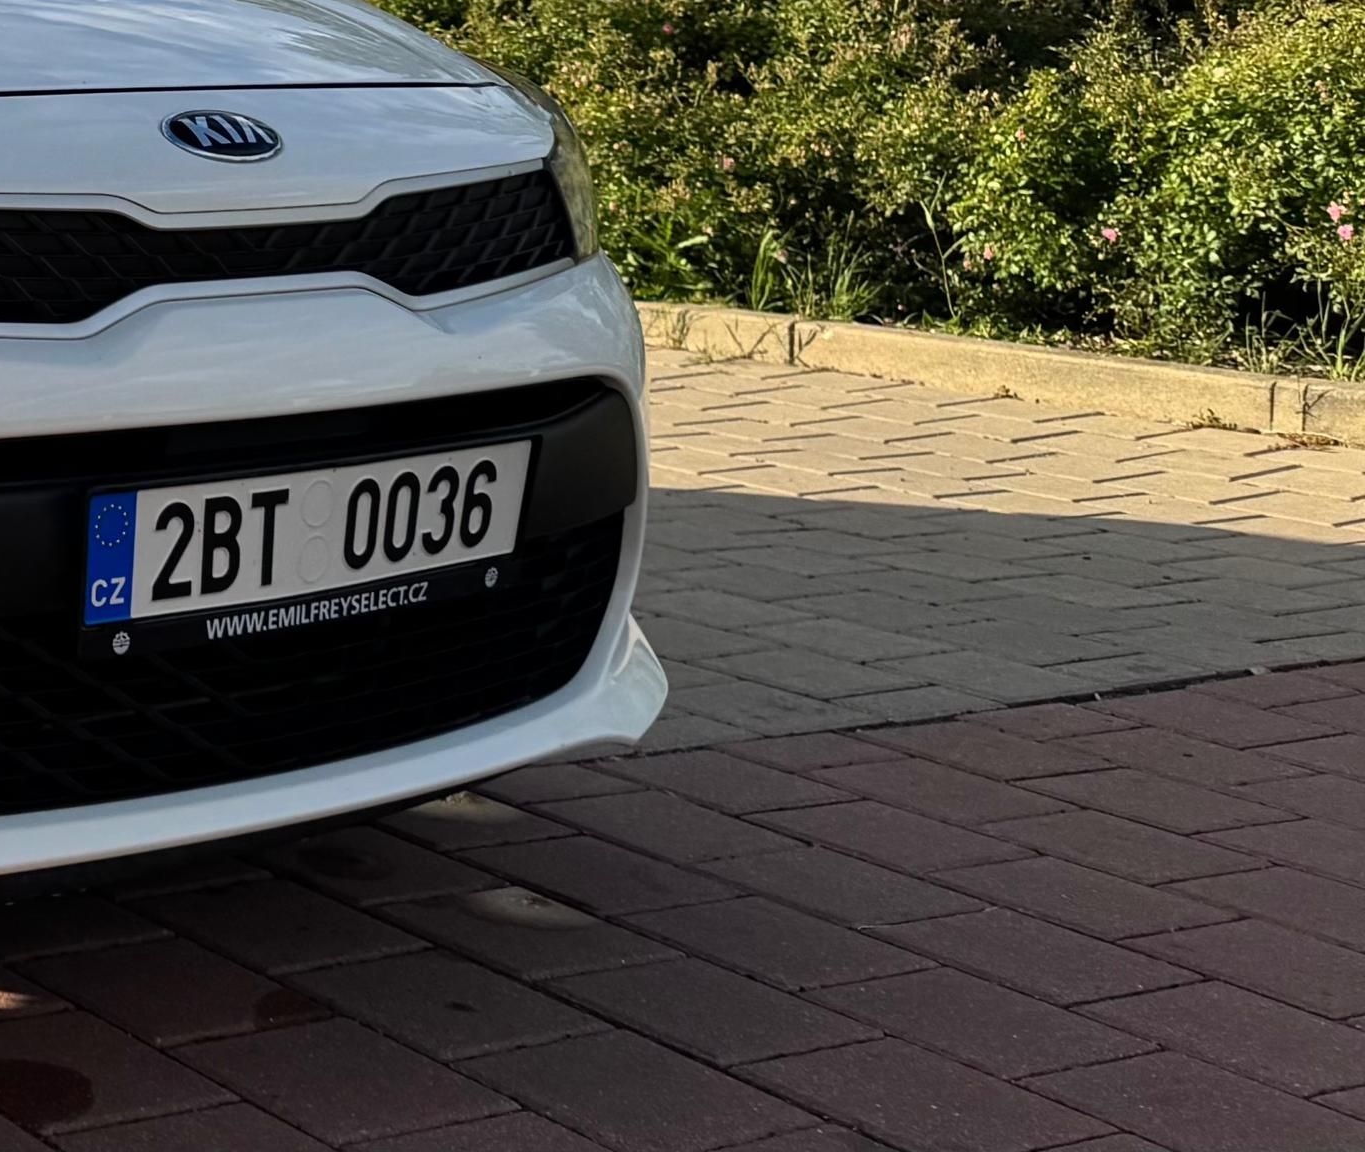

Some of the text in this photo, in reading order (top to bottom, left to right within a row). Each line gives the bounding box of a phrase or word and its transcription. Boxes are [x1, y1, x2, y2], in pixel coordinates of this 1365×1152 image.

[175, 113, 276, 149] KIA
[150, 459, 498, 602] 2BT 0036
[90, 576, 126, 608] CZ
[205, 580, 429, 640] WWW.EMILFREYSELECT.CZ
